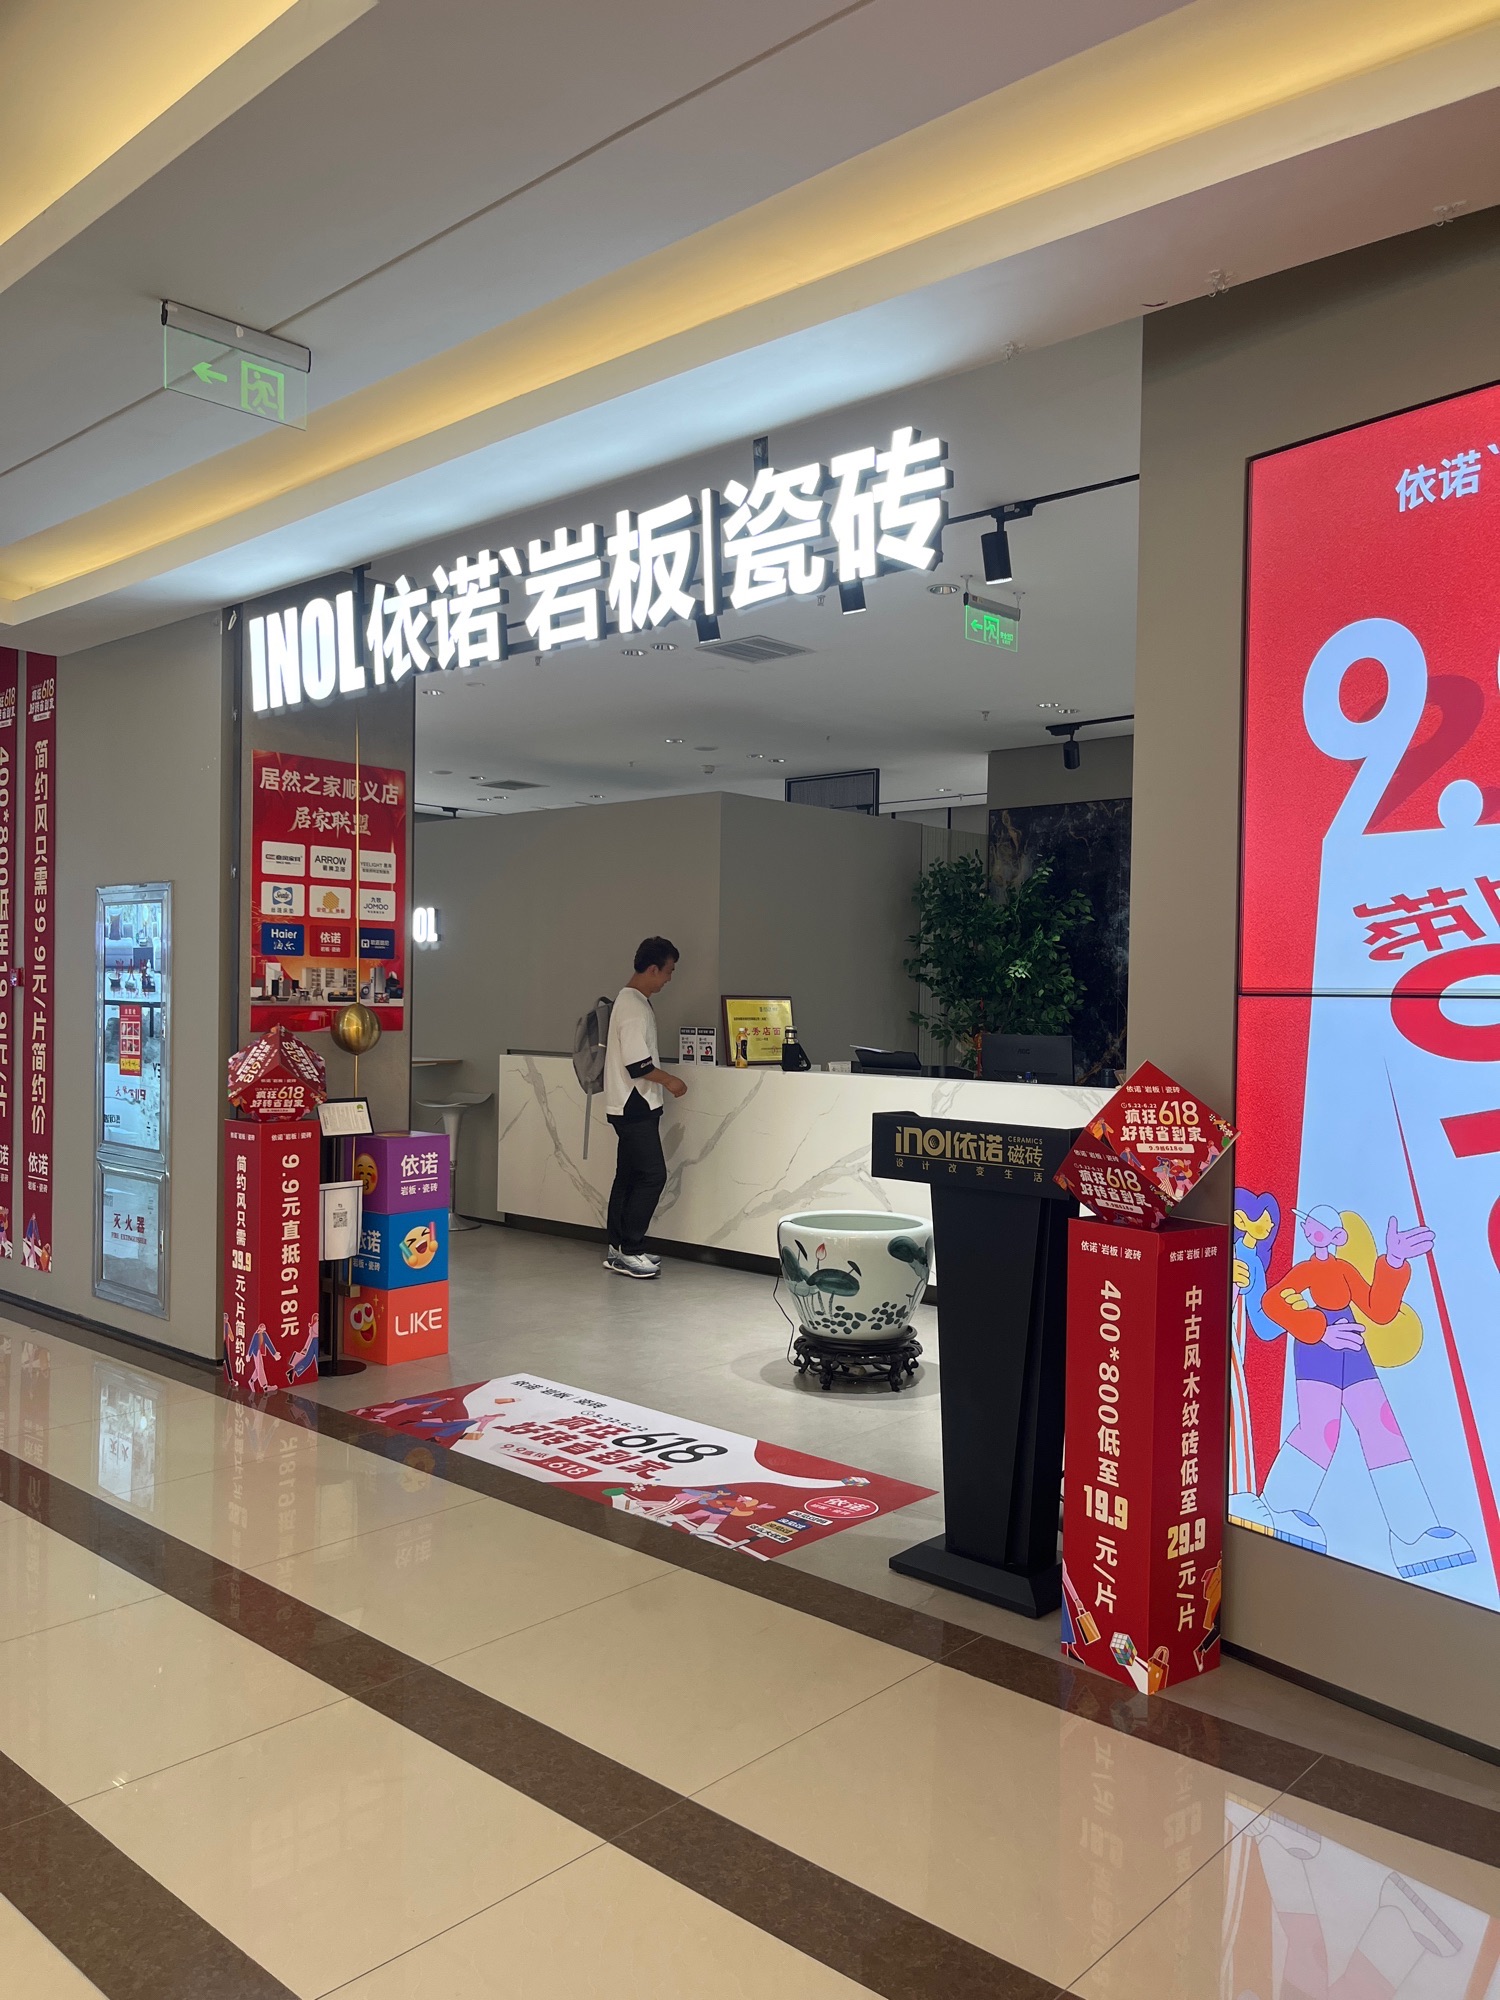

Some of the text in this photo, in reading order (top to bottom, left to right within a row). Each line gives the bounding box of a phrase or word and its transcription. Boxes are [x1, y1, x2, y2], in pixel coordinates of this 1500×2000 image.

[248, 588, 365, 713] INOL
[259, 766, 400, 806] 居然之家顺义店
[287, 805, 372, 839] 居家联盟
[315, 855, 347, 865] ARROW
[363, 903, 389, 911] JOMOO
[271, 929, 298, 939] Haier
[320, 932, 341, 945] 依诺
[256, 1086, 305, 1099] 疯狂618
[1124, 1100, 1199, 1125] 疯狂618
[1007, 1135, 1043, 1145] CERAMICS
[1120, 1125, 1206, 1142] 好砖省到家
[953, 1131, 1003, 1163] 依诺
[1007, 1144, 1043, 1167] 磁砖
[28, 1152, 49, 1176] 依诺
[401, 1151, 439, 1177] 依诺
[1079, 1166, 1141, 1192] 疯狂618
[1080, 1182, 1152, 1208] 好砖省到家
[113, 1212, 145, 1234] 灭火器
[280, 1154, 300, 1338] 9.9元直抵618元
[394, 1307, 443, 1336] LIKE
[491, 1421, 674, 1480] 好砖省到家
[824, 1497, 871, 1512] 依诺
